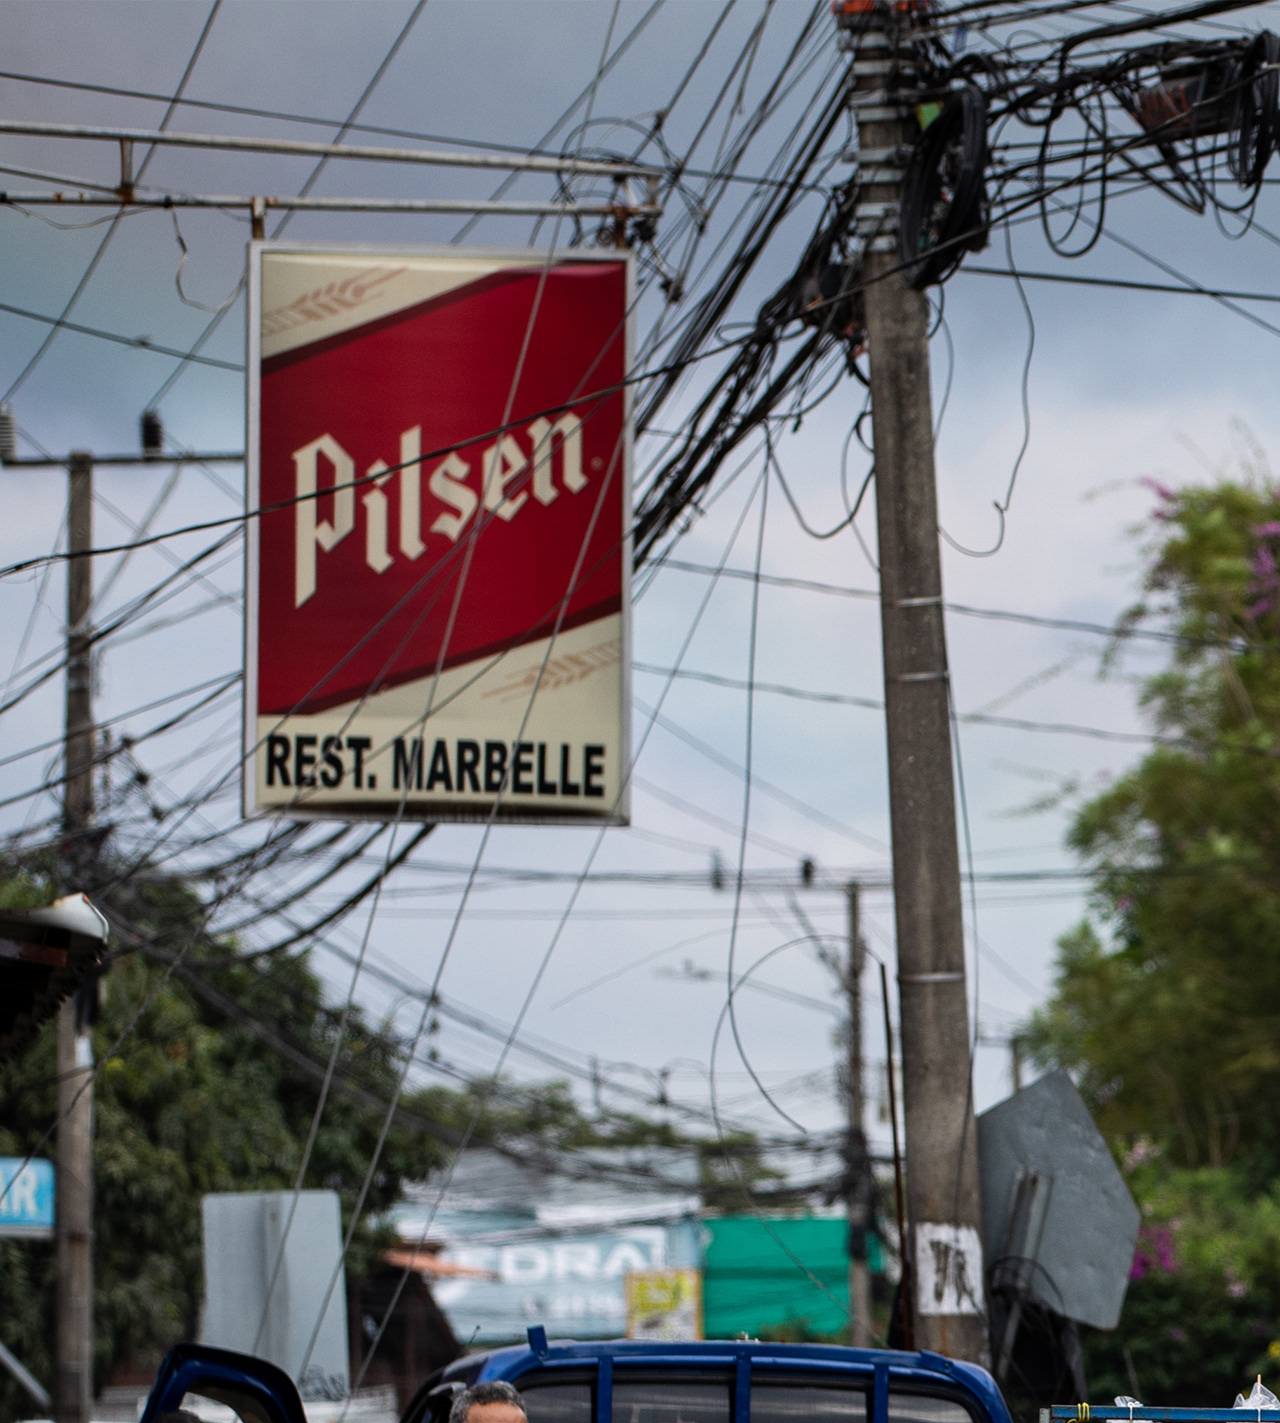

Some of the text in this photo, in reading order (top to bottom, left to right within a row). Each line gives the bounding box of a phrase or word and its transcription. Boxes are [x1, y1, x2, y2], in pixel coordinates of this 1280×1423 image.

[292, 411, 589, 610] Pilsen
[265, 733, 606, 796] REST. MARBELLE
